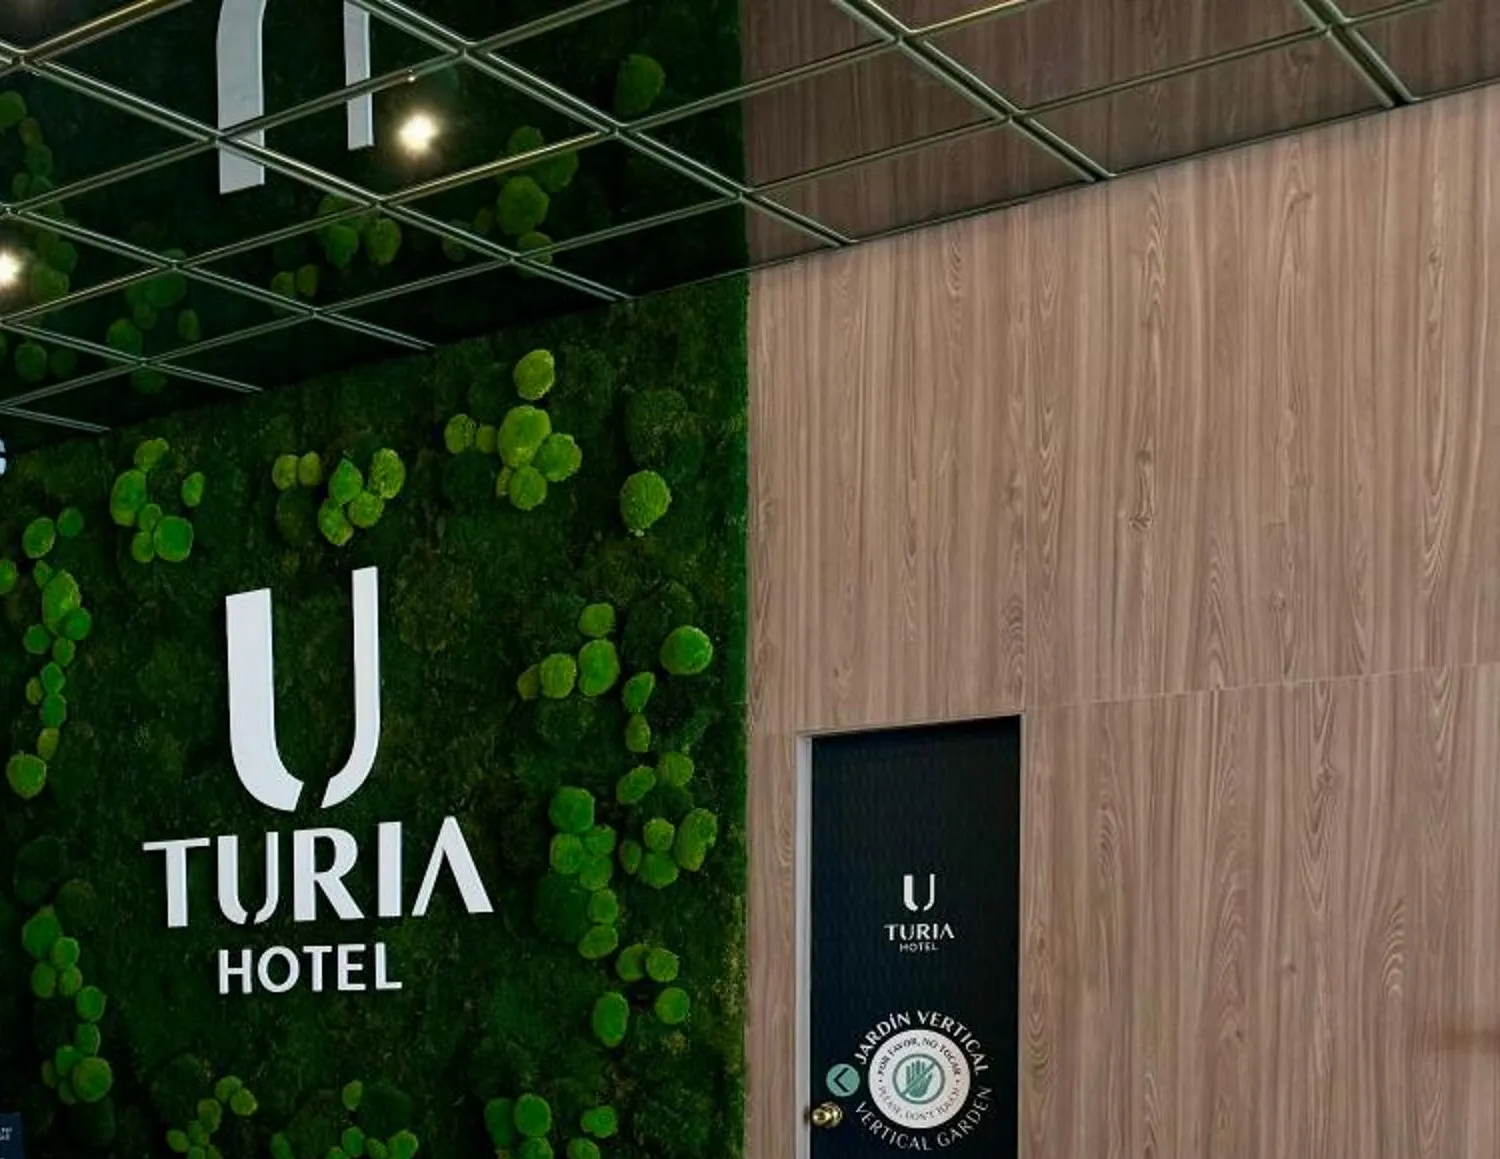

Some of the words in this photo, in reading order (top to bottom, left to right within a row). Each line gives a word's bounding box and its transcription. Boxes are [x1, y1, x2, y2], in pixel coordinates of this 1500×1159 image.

[225, 565, 381, 812] U
[142, 816, 494, 928] TURIA
[903, 873, 935, 912] U
[884, 923, 955, 941] TURIA
[899, 941, 940, 953] HOTEL
[217, 942, 402, 994] HOTEL
[854, 1010, 912, 1065] JARDÍN
[916, 1009, 990, 1077] VERTICAL
[855, 1101, 933, 1151] VERTICAL
[936, 1085, 993, 1147] GARDEN
